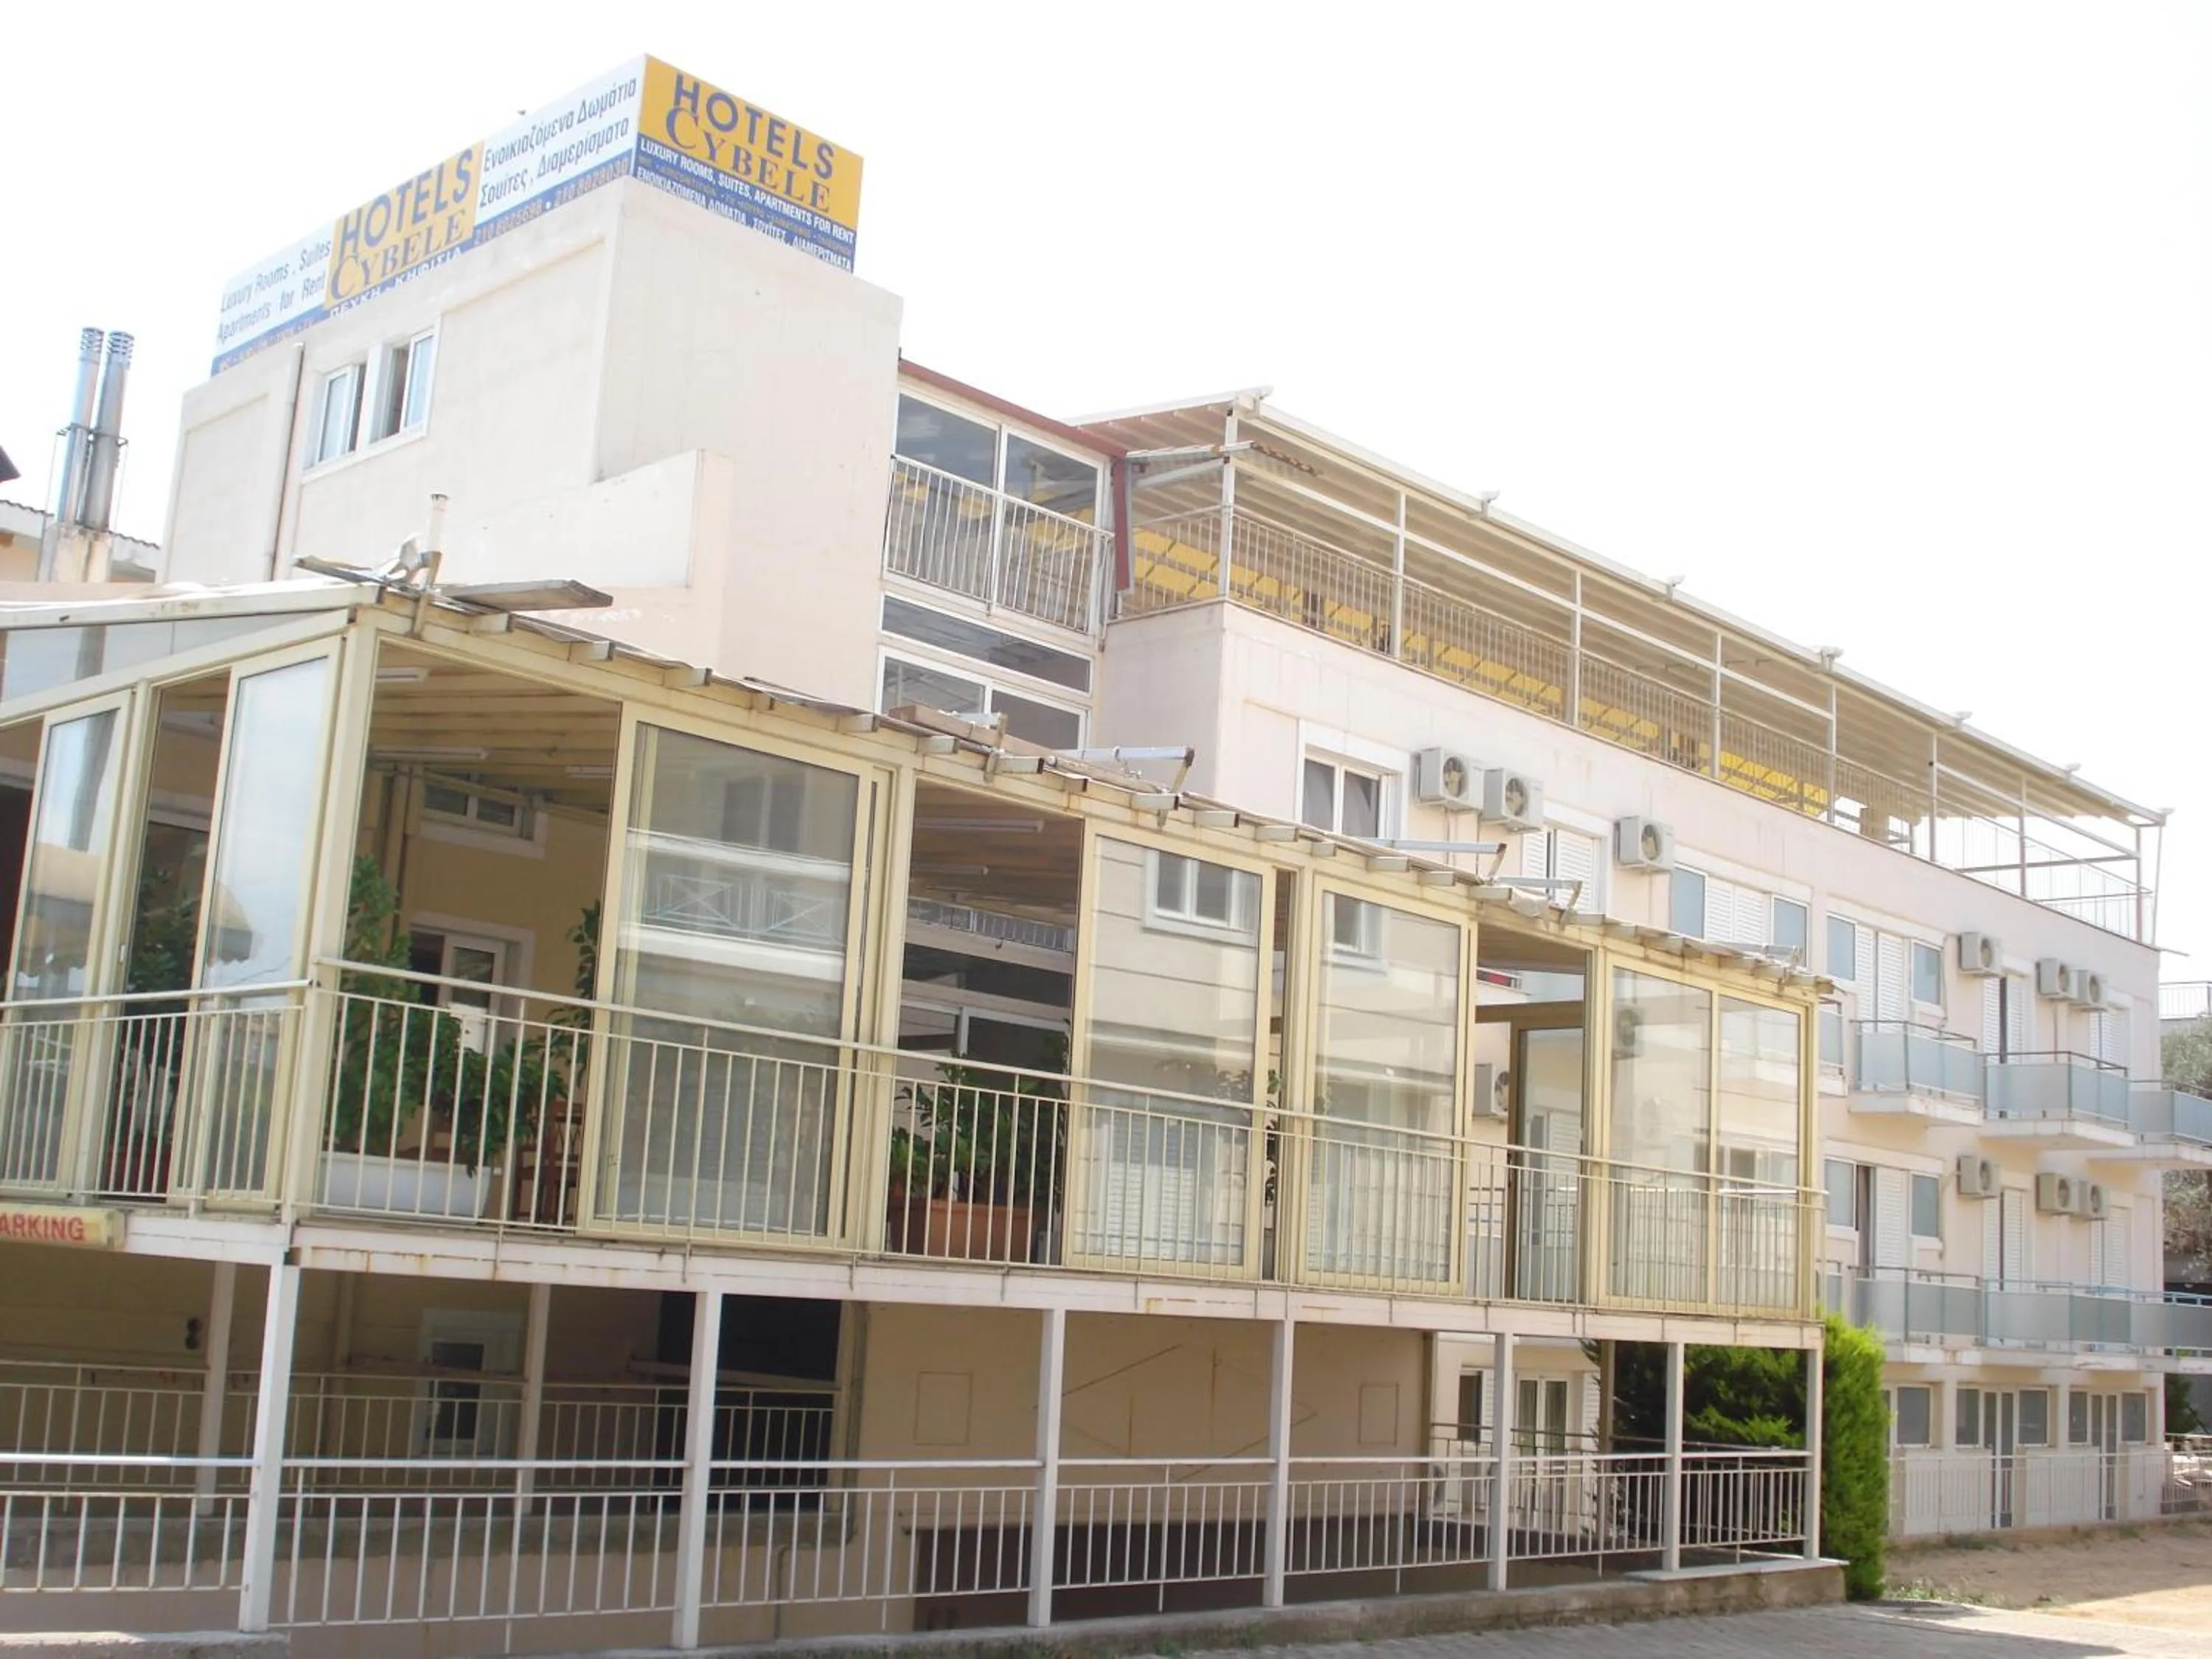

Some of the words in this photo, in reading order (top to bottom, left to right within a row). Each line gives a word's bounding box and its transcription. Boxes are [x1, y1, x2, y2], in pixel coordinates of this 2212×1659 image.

[484, 110, 574, 173] Ενοικιαζόμενα
[577, 77, 636, 125] Δωμάτια
[666, 106, 830, 213] CYBELE
[673, 73, 835, 180] HOTELS
[338, 147, 473, 258] HOTELS
[641, 137, 679, 165] LUXURY
[754, 189, 812, 226] APARTMENTS
[814, 216, 831, 234] FOR
[832, 224, 855, 245] RENT
[218, 302, 272, 345] Apartments
[279, 290, 296, 312] for
[301, 269, 326, 301] Rent
[331, 209, 467, 300] CYBELE
